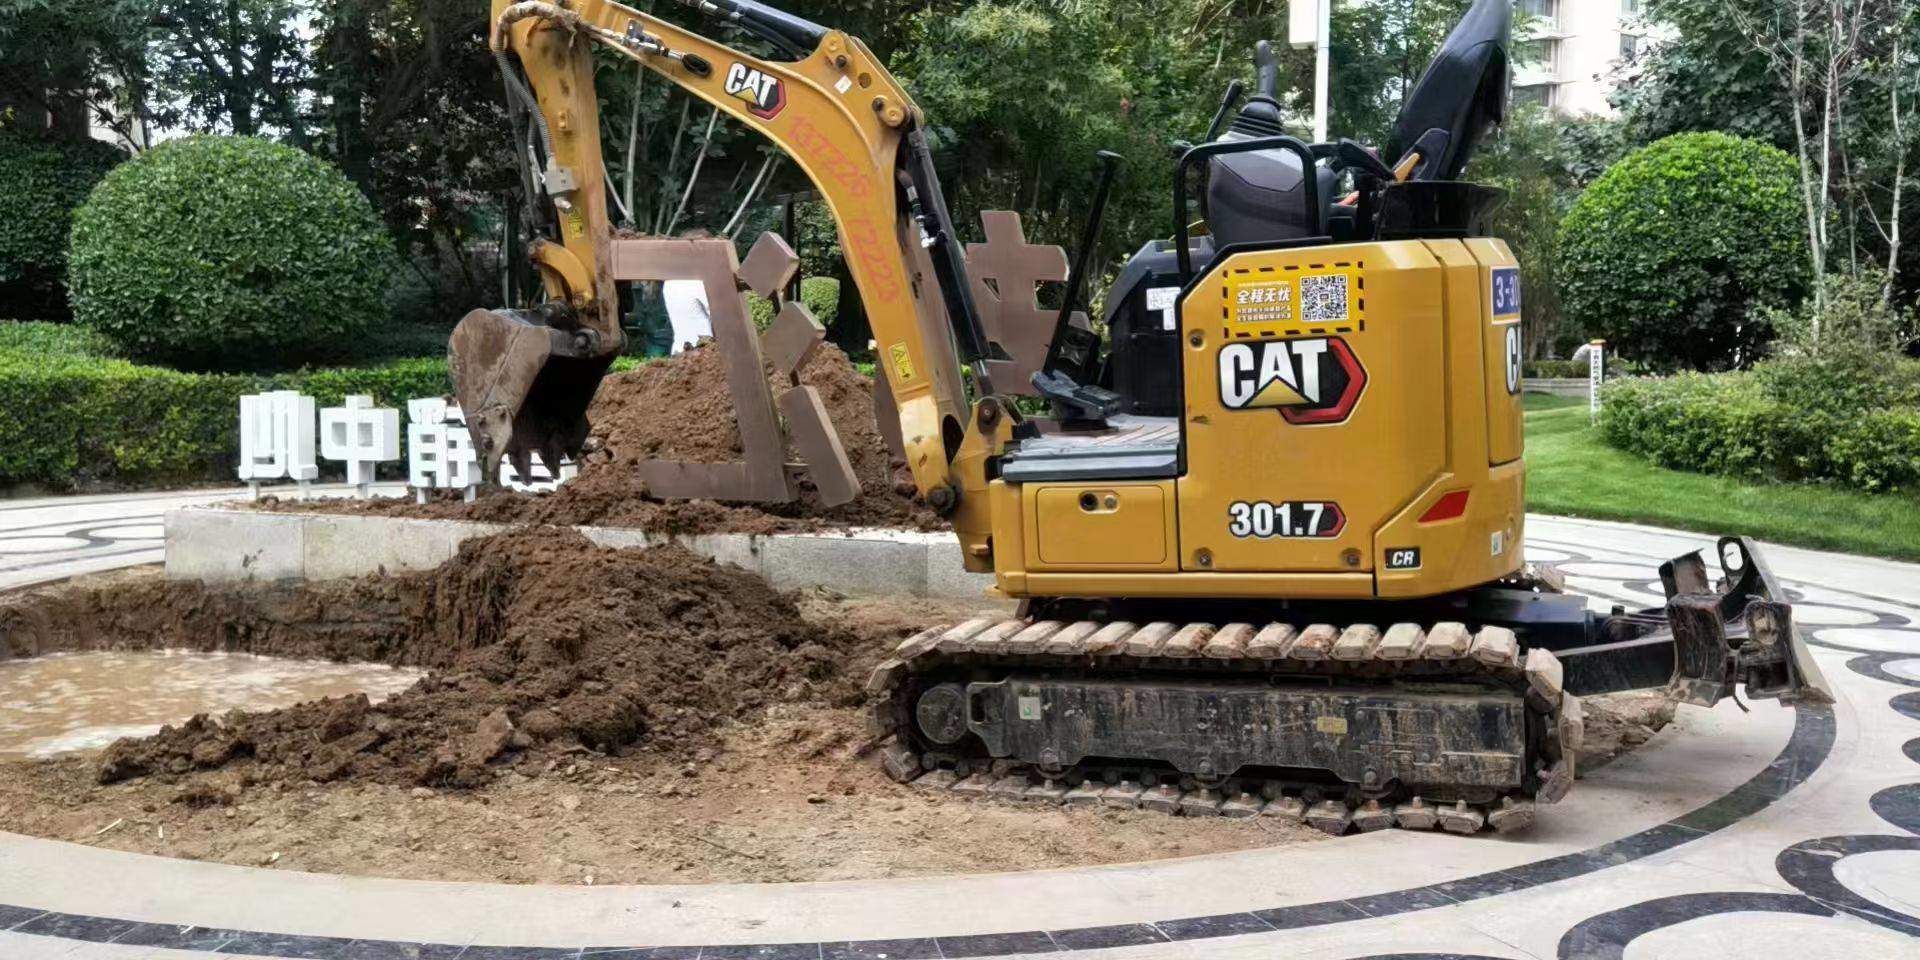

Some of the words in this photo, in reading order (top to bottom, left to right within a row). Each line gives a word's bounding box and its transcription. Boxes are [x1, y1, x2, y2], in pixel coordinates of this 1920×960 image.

[726, 63, 778, 107] CAT
[1237, 287, 1291, 305] 全程无忧
[1219, 338, 1328, 408] CAT
[1229, 502, 1325, 537] 301.7
[1391, 550, 1414, 566] CR
